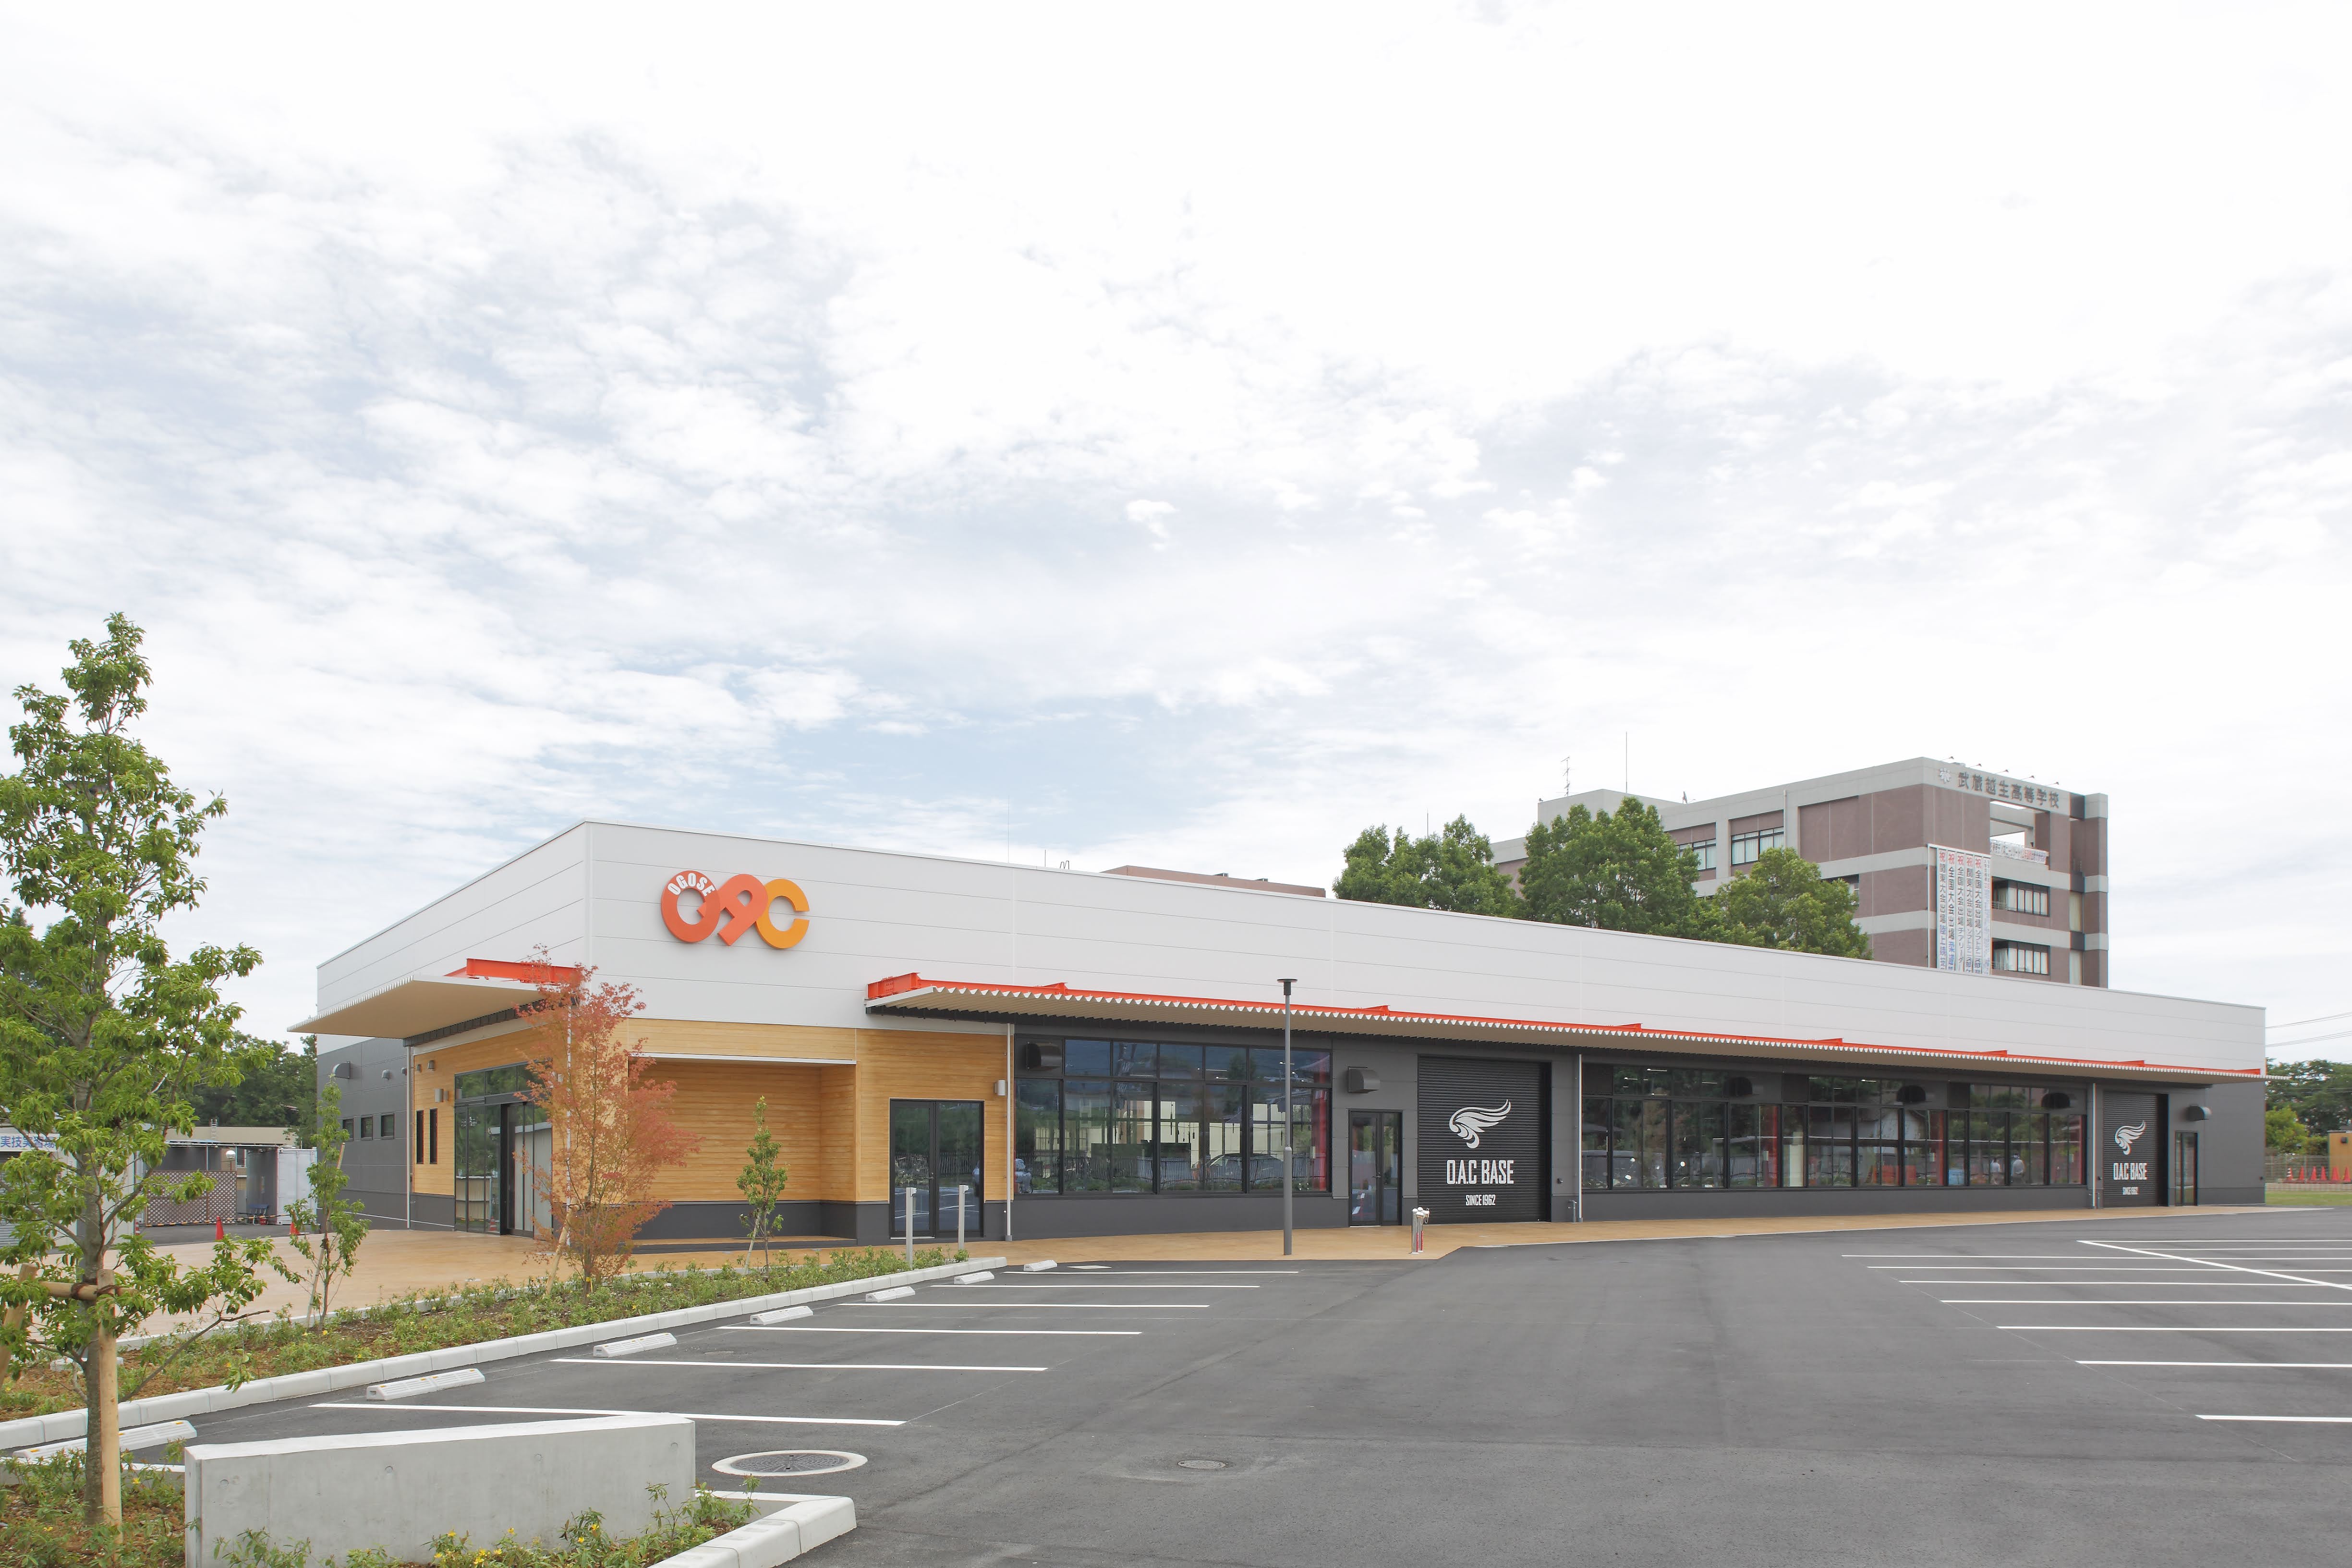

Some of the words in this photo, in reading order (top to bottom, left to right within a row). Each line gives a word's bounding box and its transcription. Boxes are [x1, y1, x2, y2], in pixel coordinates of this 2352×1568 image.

[1957, 772, 2060, 809] 武蔵越生高等学校
[667, 873, 715, 897] OGOSE
[1446, 1160, 1477, 1184] O.A.C
[1481, 1160, 1514, 1184] BASE
[2130, 1162, 2147, 1180] BASE
[1466, 1194, 1482, 1206] SINCE
[1482, 1194, 1496, 1206] 1962
